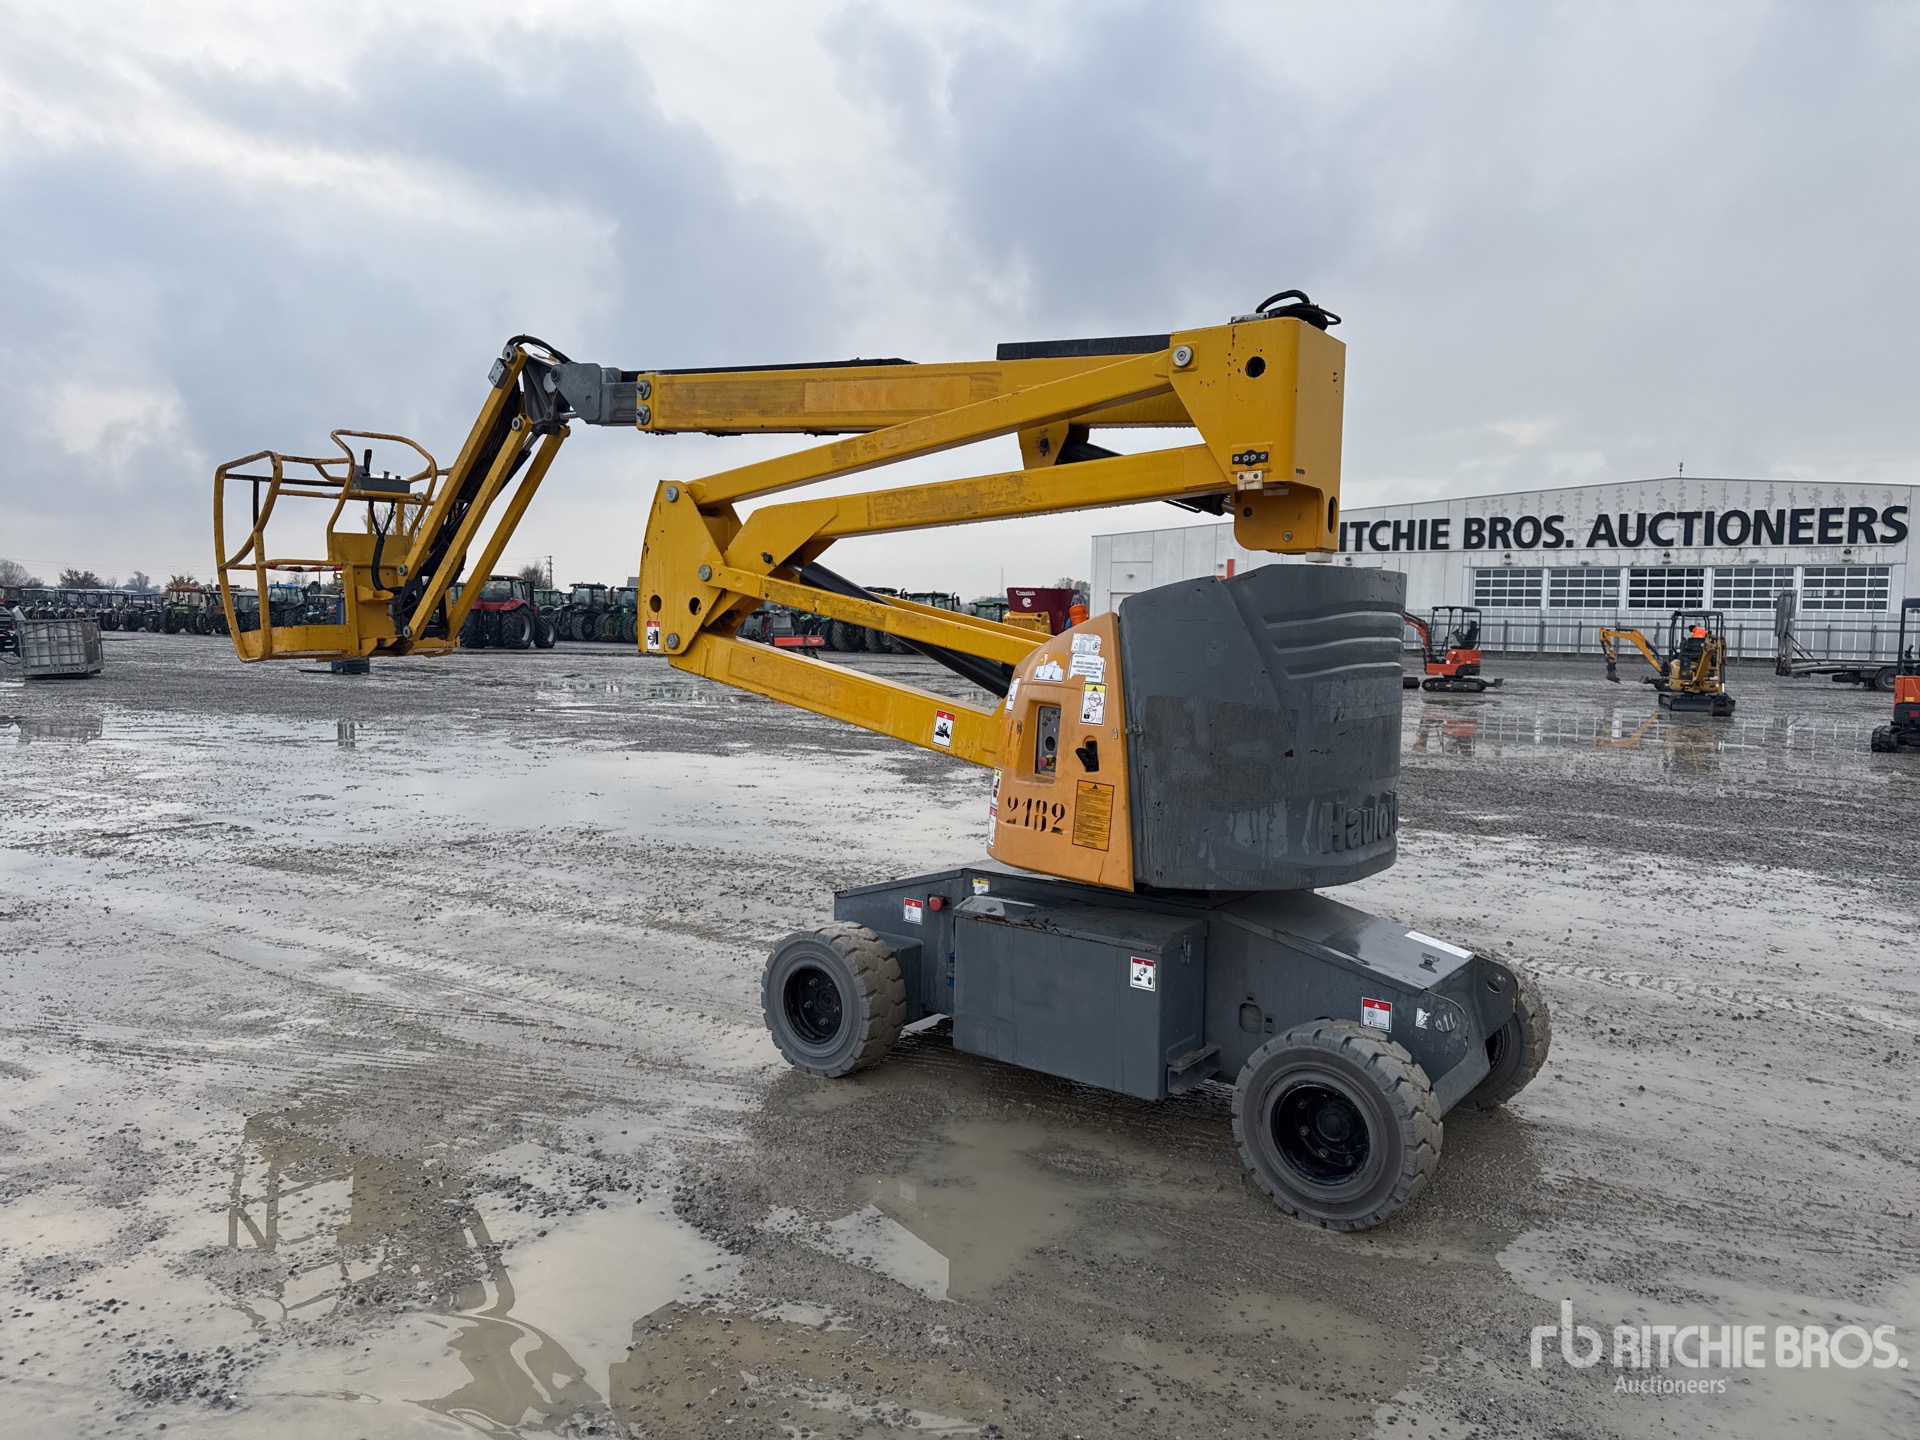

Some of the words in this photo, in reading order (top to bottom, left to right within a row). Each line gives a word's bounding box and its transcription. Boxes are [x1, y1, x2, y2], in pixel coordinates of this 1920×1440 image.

[1339, 518, 1450, 552] ITCHIE
[1463, 515, 1574, 550] BROS.
[1586, 505, 1908, 547] AUCTIONEERS
